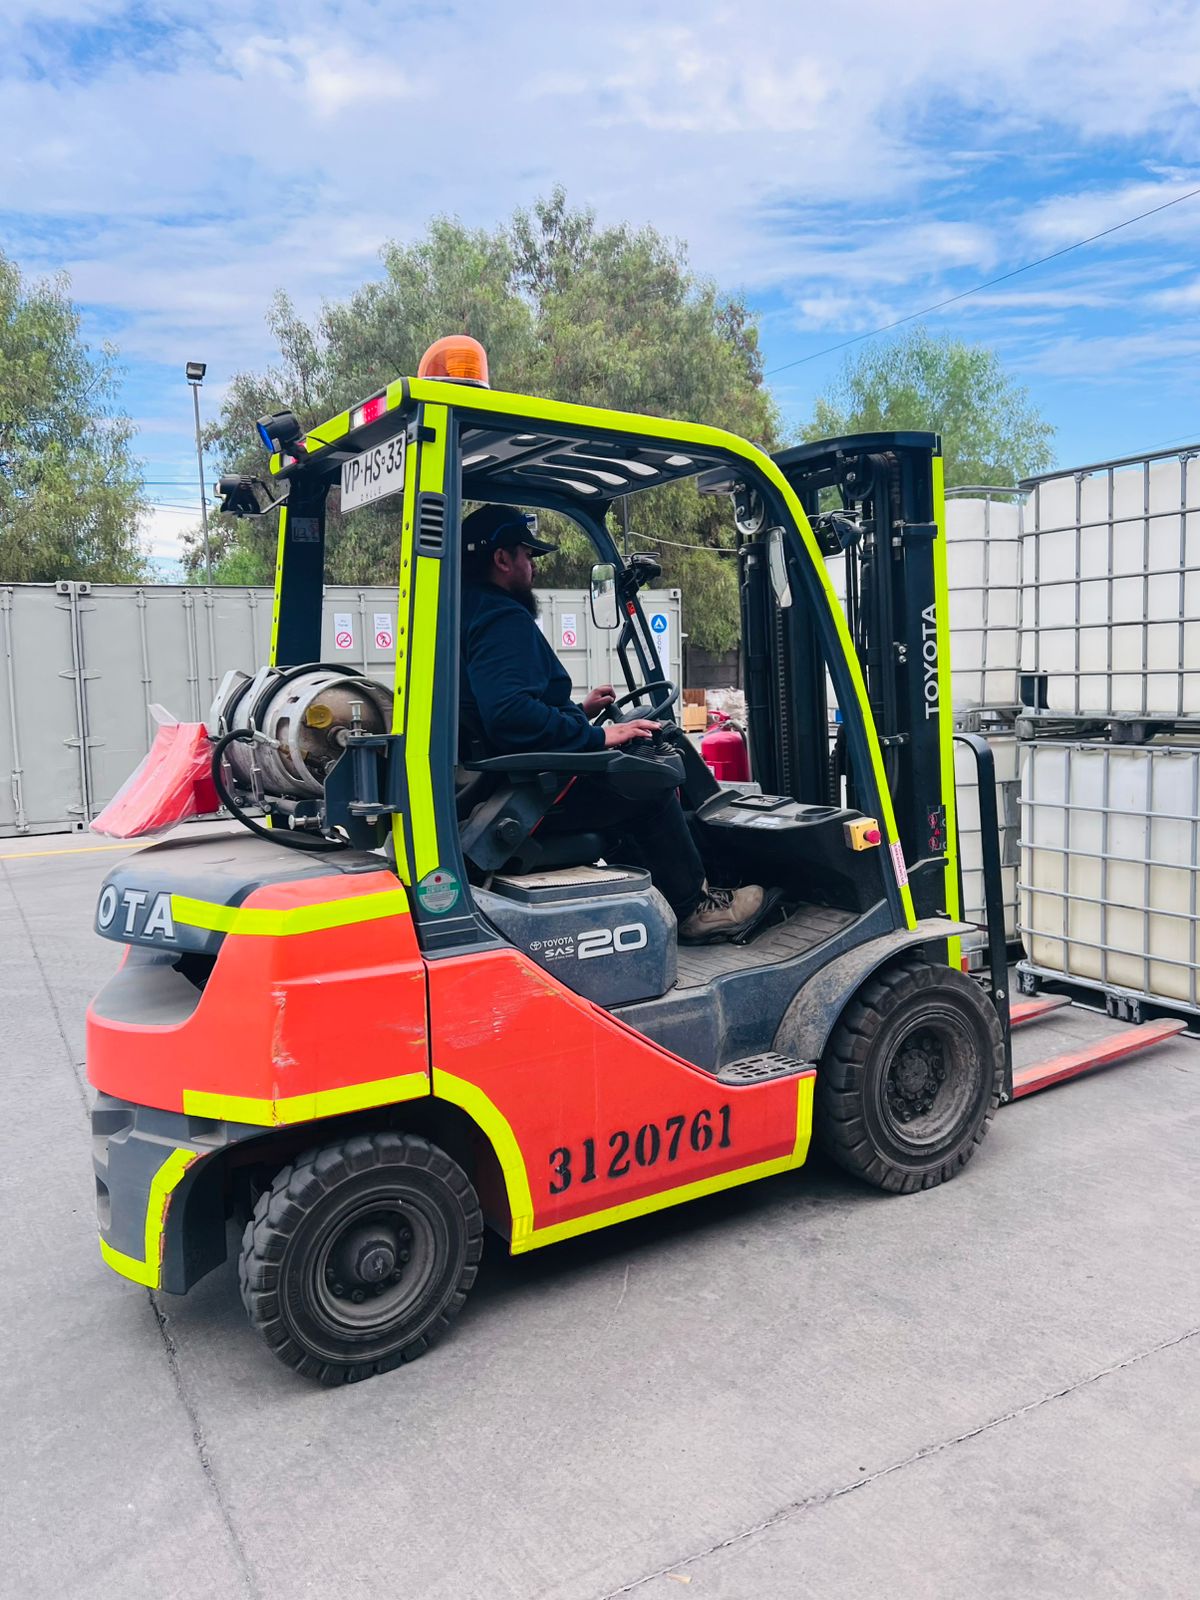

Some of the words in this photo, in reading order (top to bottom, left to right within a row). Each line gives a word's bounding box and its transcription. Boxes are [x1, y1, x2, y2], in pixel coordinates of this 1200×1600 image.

[922, 602, 940, 720] TOYOTA
[98, 885, 175, 938] OTA
[542, 936, 574, 948] TOYOTA
[544, 945, 575, 959] SAS
[577, 922, 648, 960] 20
[549, 1104, 731, 1195] 3120761
